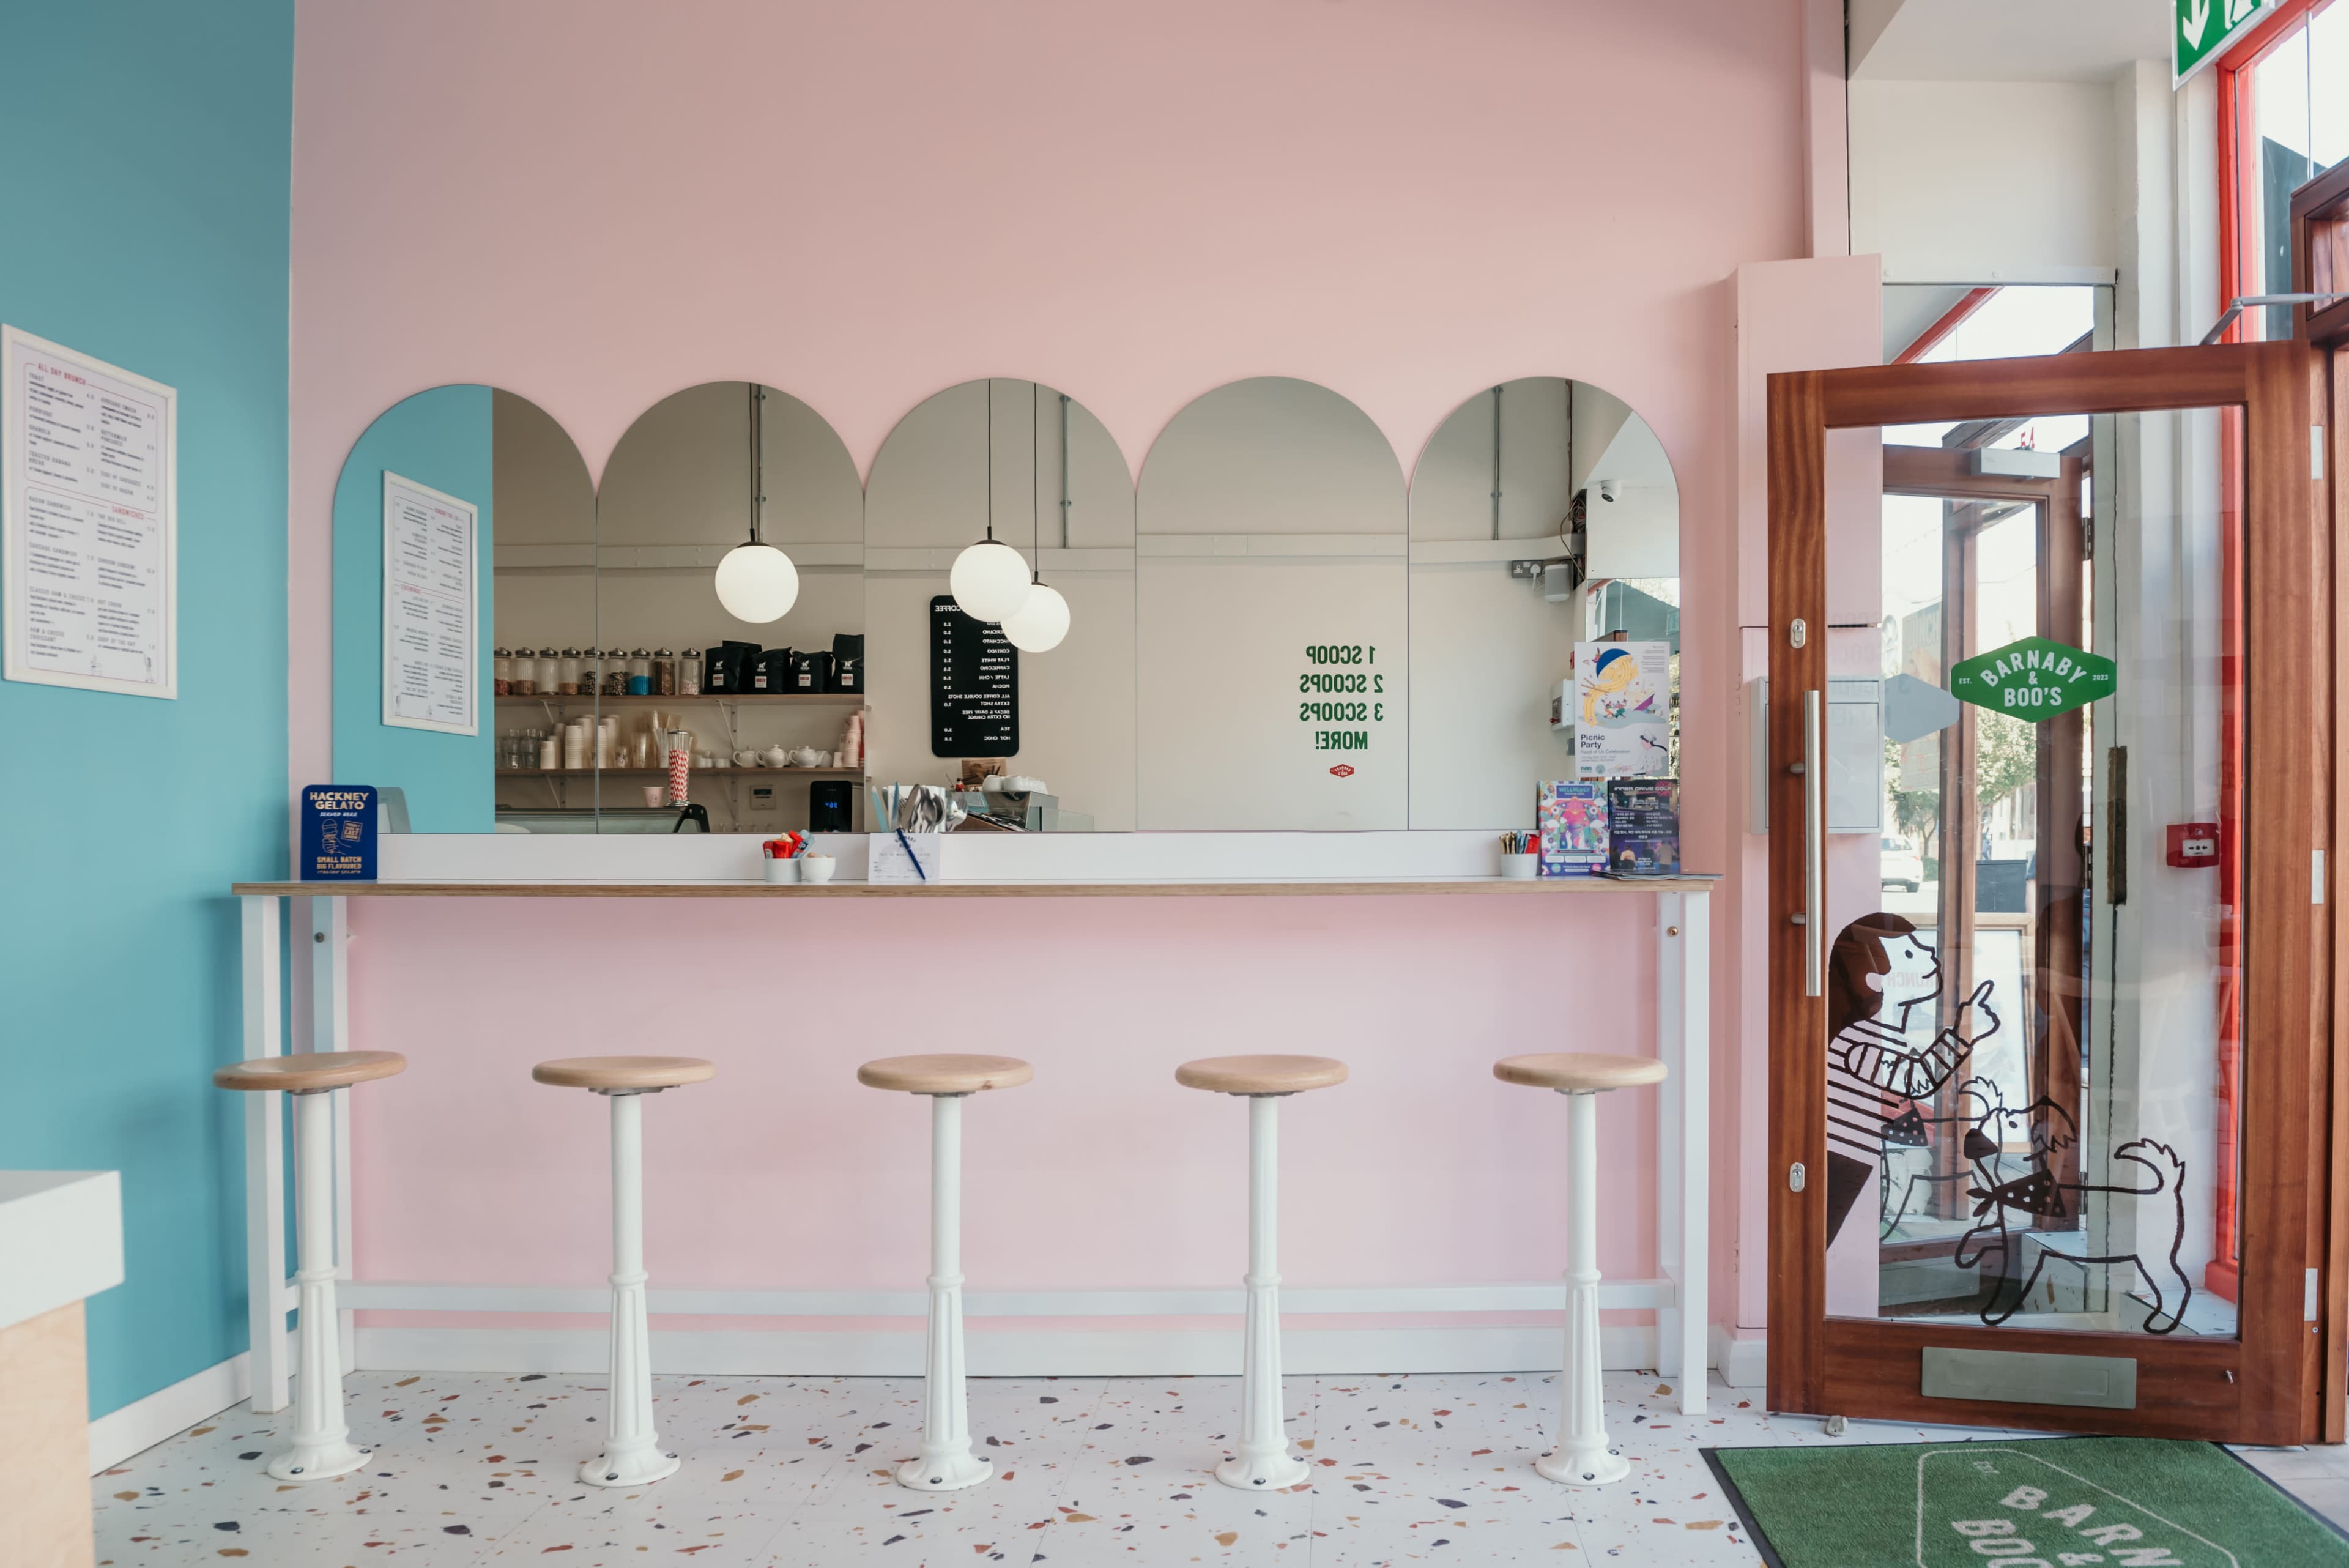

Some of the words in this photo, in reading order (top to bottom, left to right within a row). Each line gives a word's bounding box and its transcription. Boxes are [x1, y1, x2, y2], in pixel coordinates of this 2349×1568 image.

[1980, 650, 2087, 687] BARNABY
[2028, 671, 2038, 685] &
[2005, 687, 2062, 707] BOO'S
[310, 792, 369, 801] HACKNEY
[314, 801, 365, 810] GELATO
[2000, 1485, 2184, 1566] BARN
